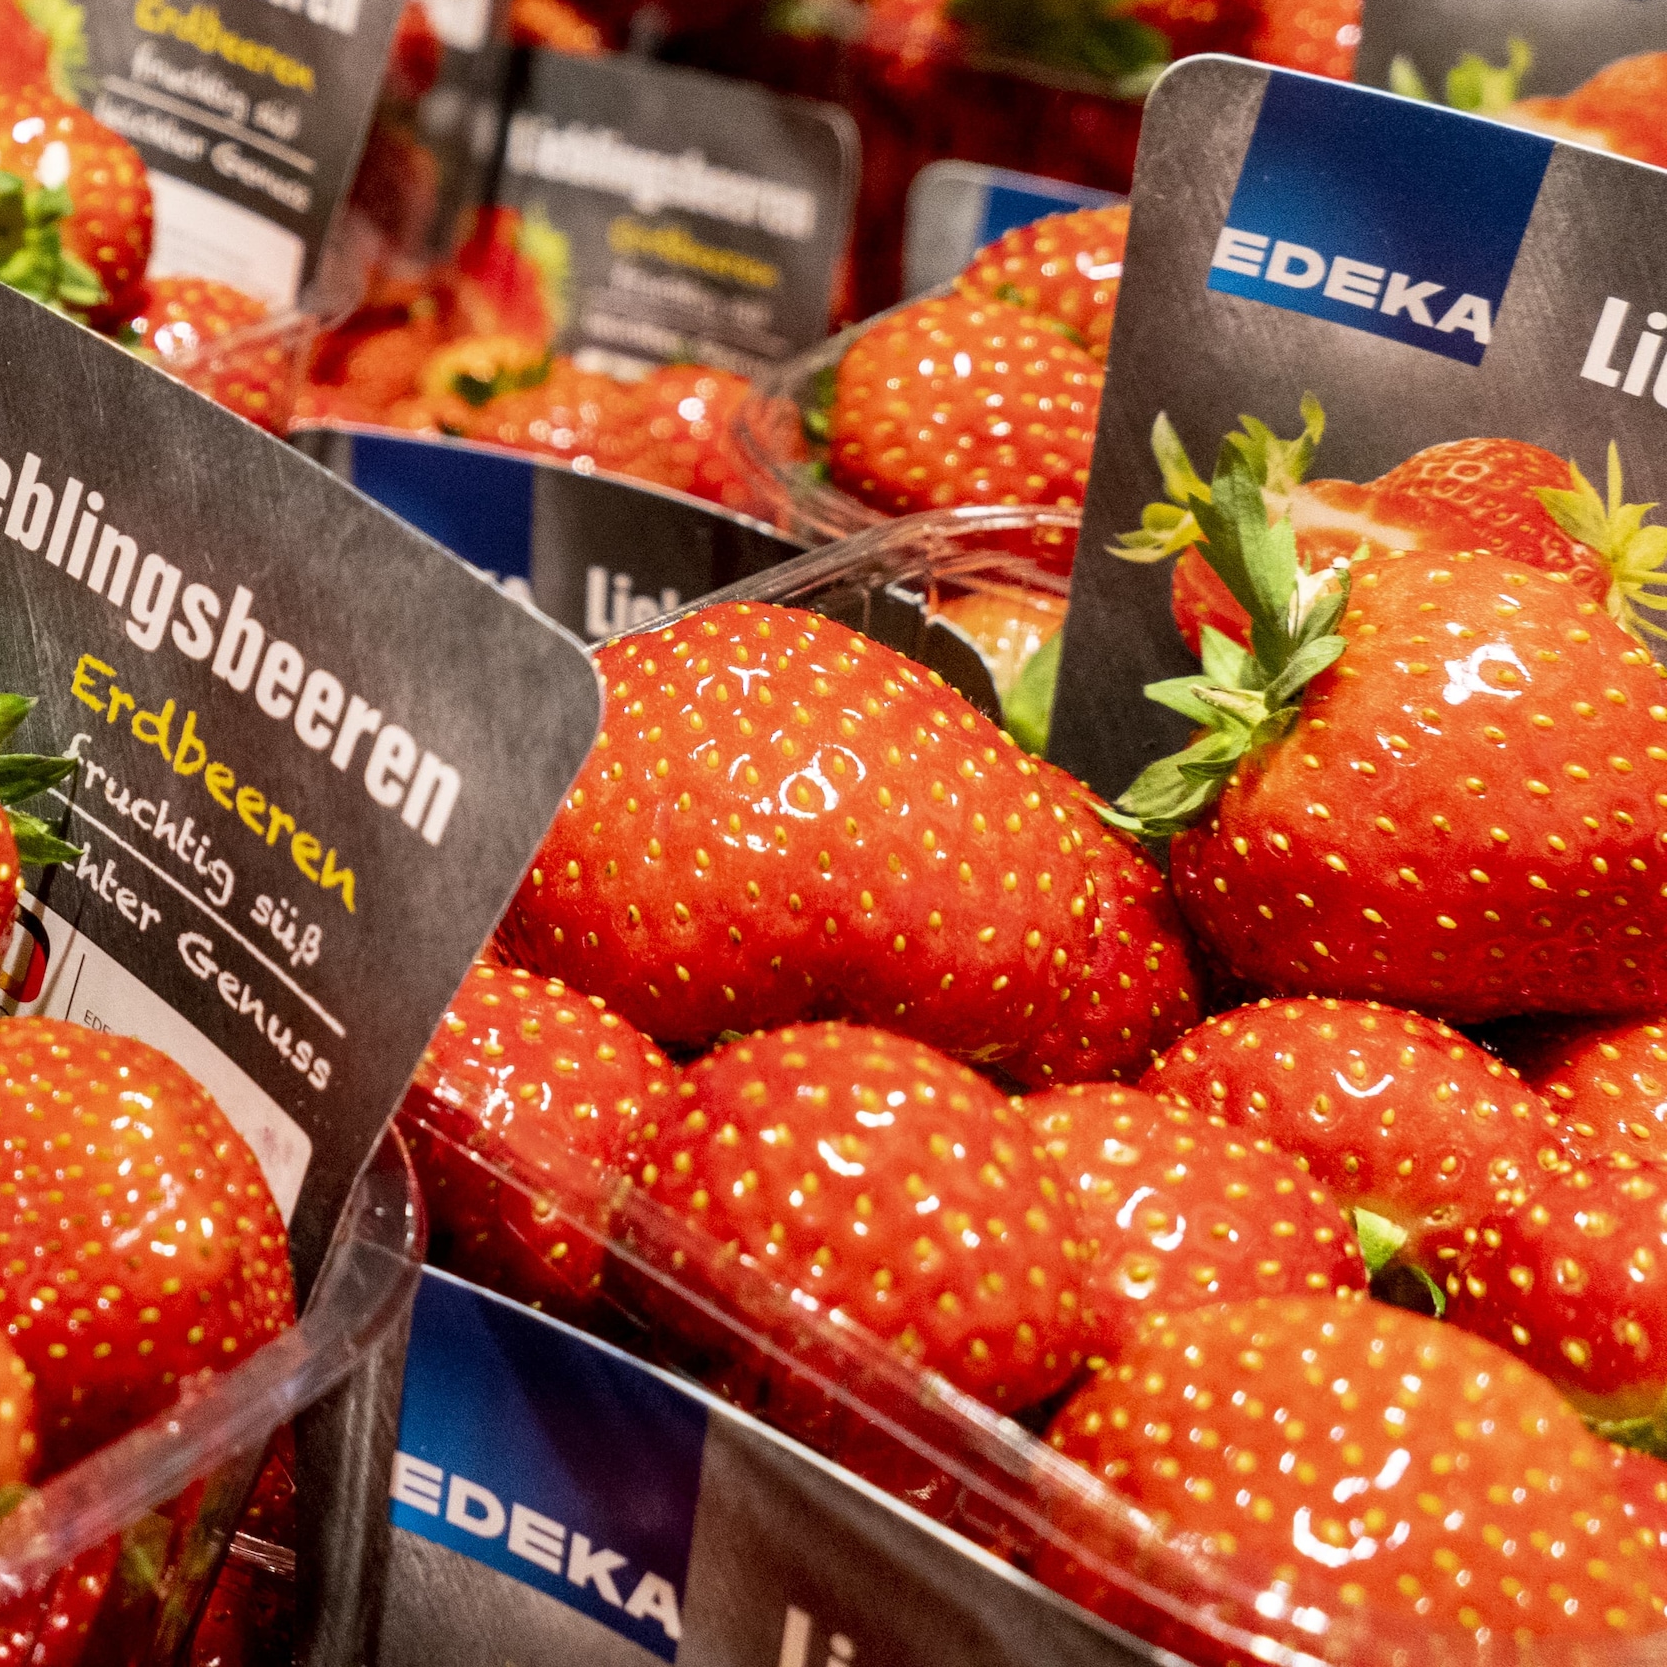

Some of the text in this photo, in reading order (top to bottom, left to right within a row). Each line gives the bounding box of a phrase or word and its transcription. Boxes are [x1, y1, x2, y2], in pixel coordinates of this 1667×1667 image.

[1211, 226, 1492, 345] EDEKA
[62, 732, 323, 967] fruchtig süß
[71, 653, 357, 914] Erdbeeren
[177, 932, 333, 1091] Genuss
[389, 1449, 683, 1639] EDEKA
